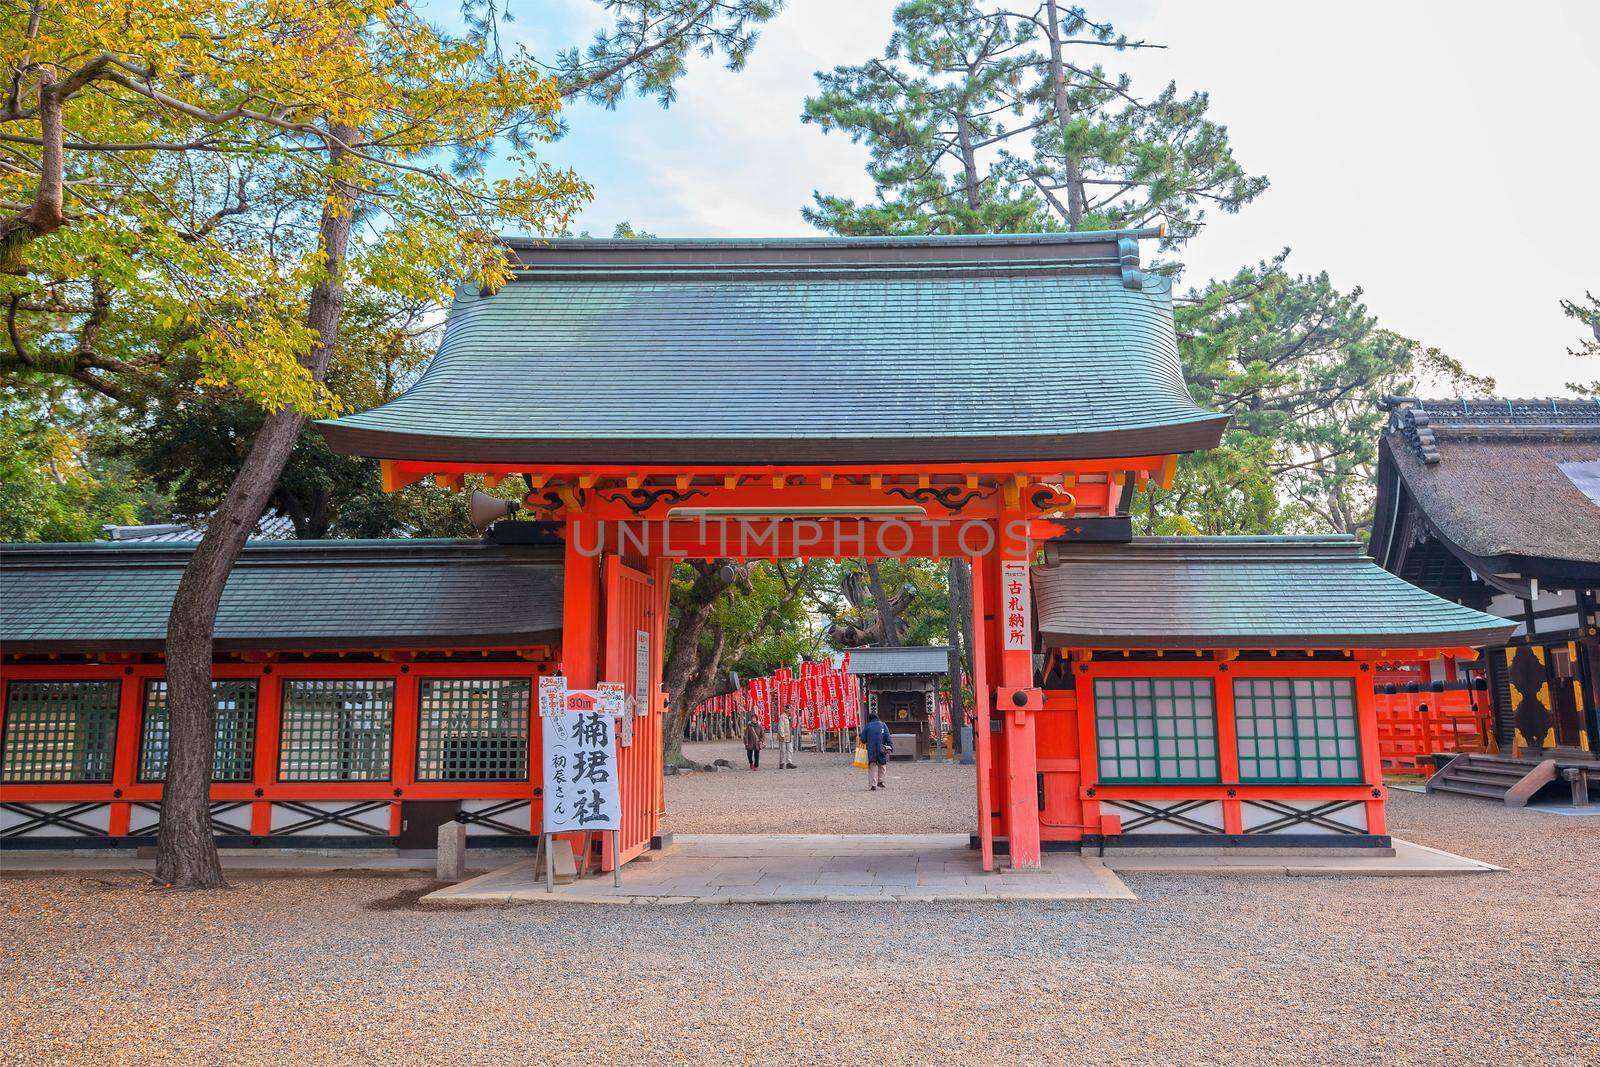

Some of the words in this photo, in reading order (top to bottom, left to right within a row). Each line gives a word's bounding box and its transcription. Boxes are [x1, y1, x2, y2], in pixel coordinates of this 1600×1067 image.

[1008, 580, 1024, 645] 古札納所
[569, 698, 591, 709] 30m
[571, 712, 610, 826] 楠珺社
